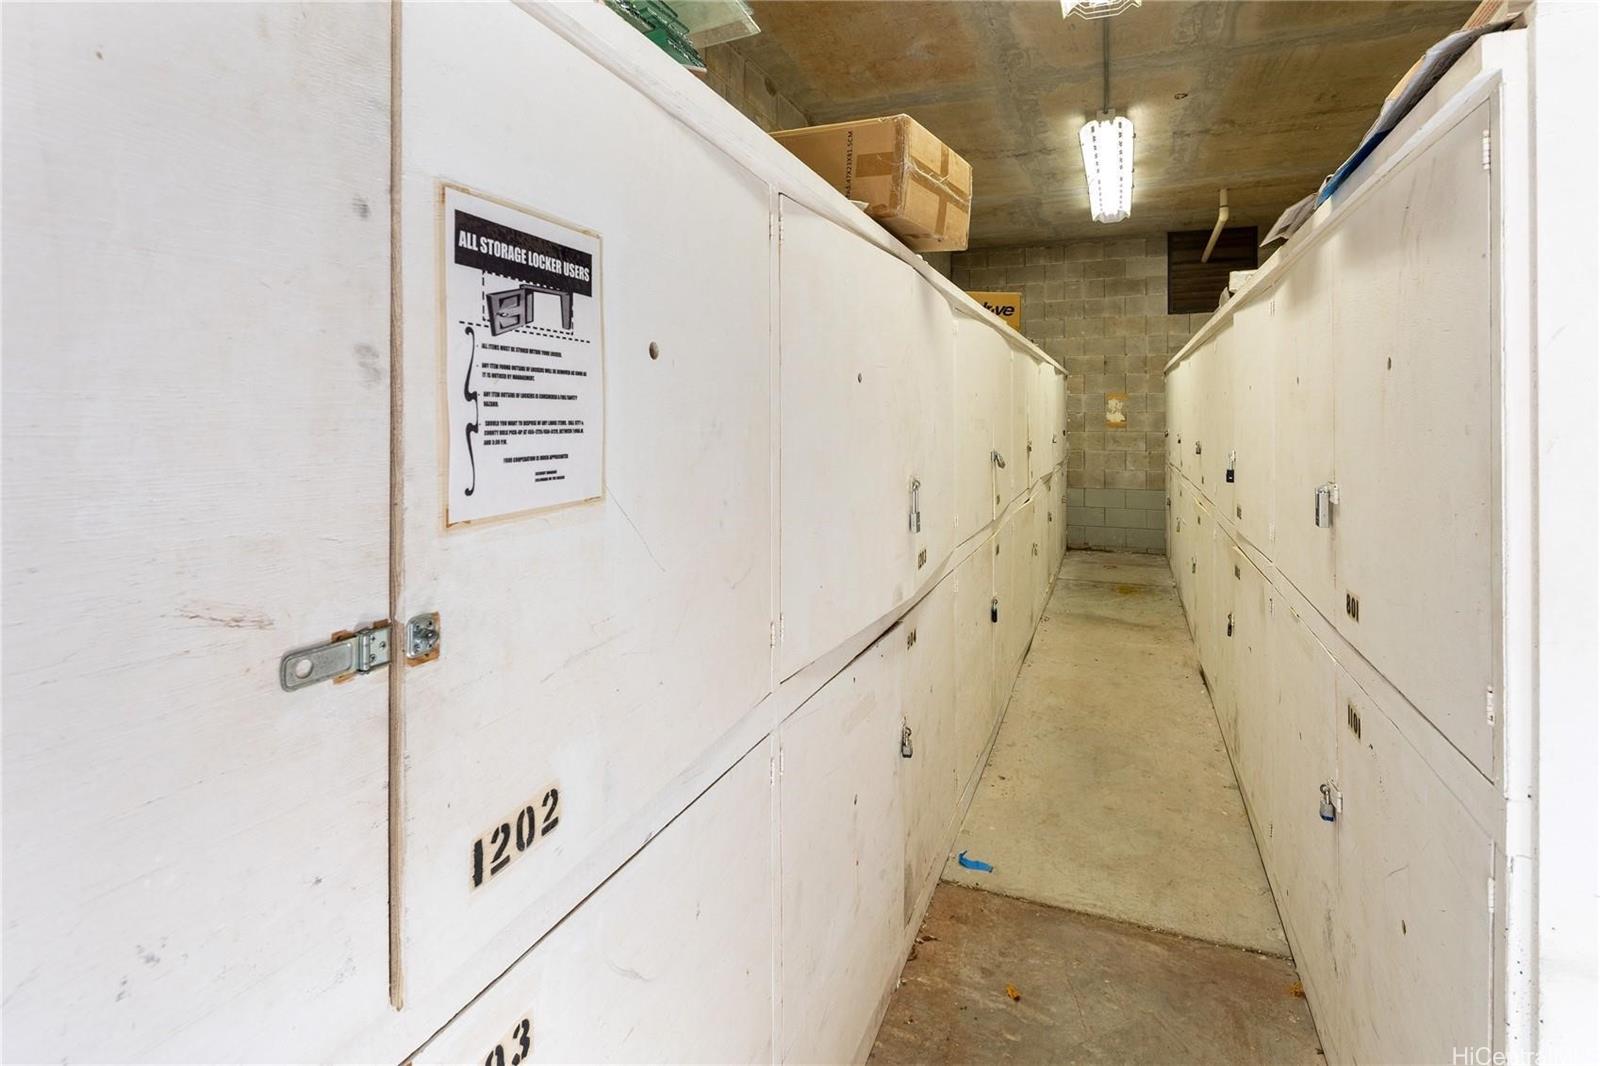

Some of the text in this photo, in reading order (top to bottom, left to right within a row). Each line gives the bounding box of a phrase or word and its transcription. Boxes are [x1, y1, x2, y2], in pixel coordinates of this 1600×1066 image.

[458, 230, 590, 282] ALL STORAGE LOCKER USERS
[1346, 593, 1359, 622] 801
[472, 788, 559, 887] 1202
